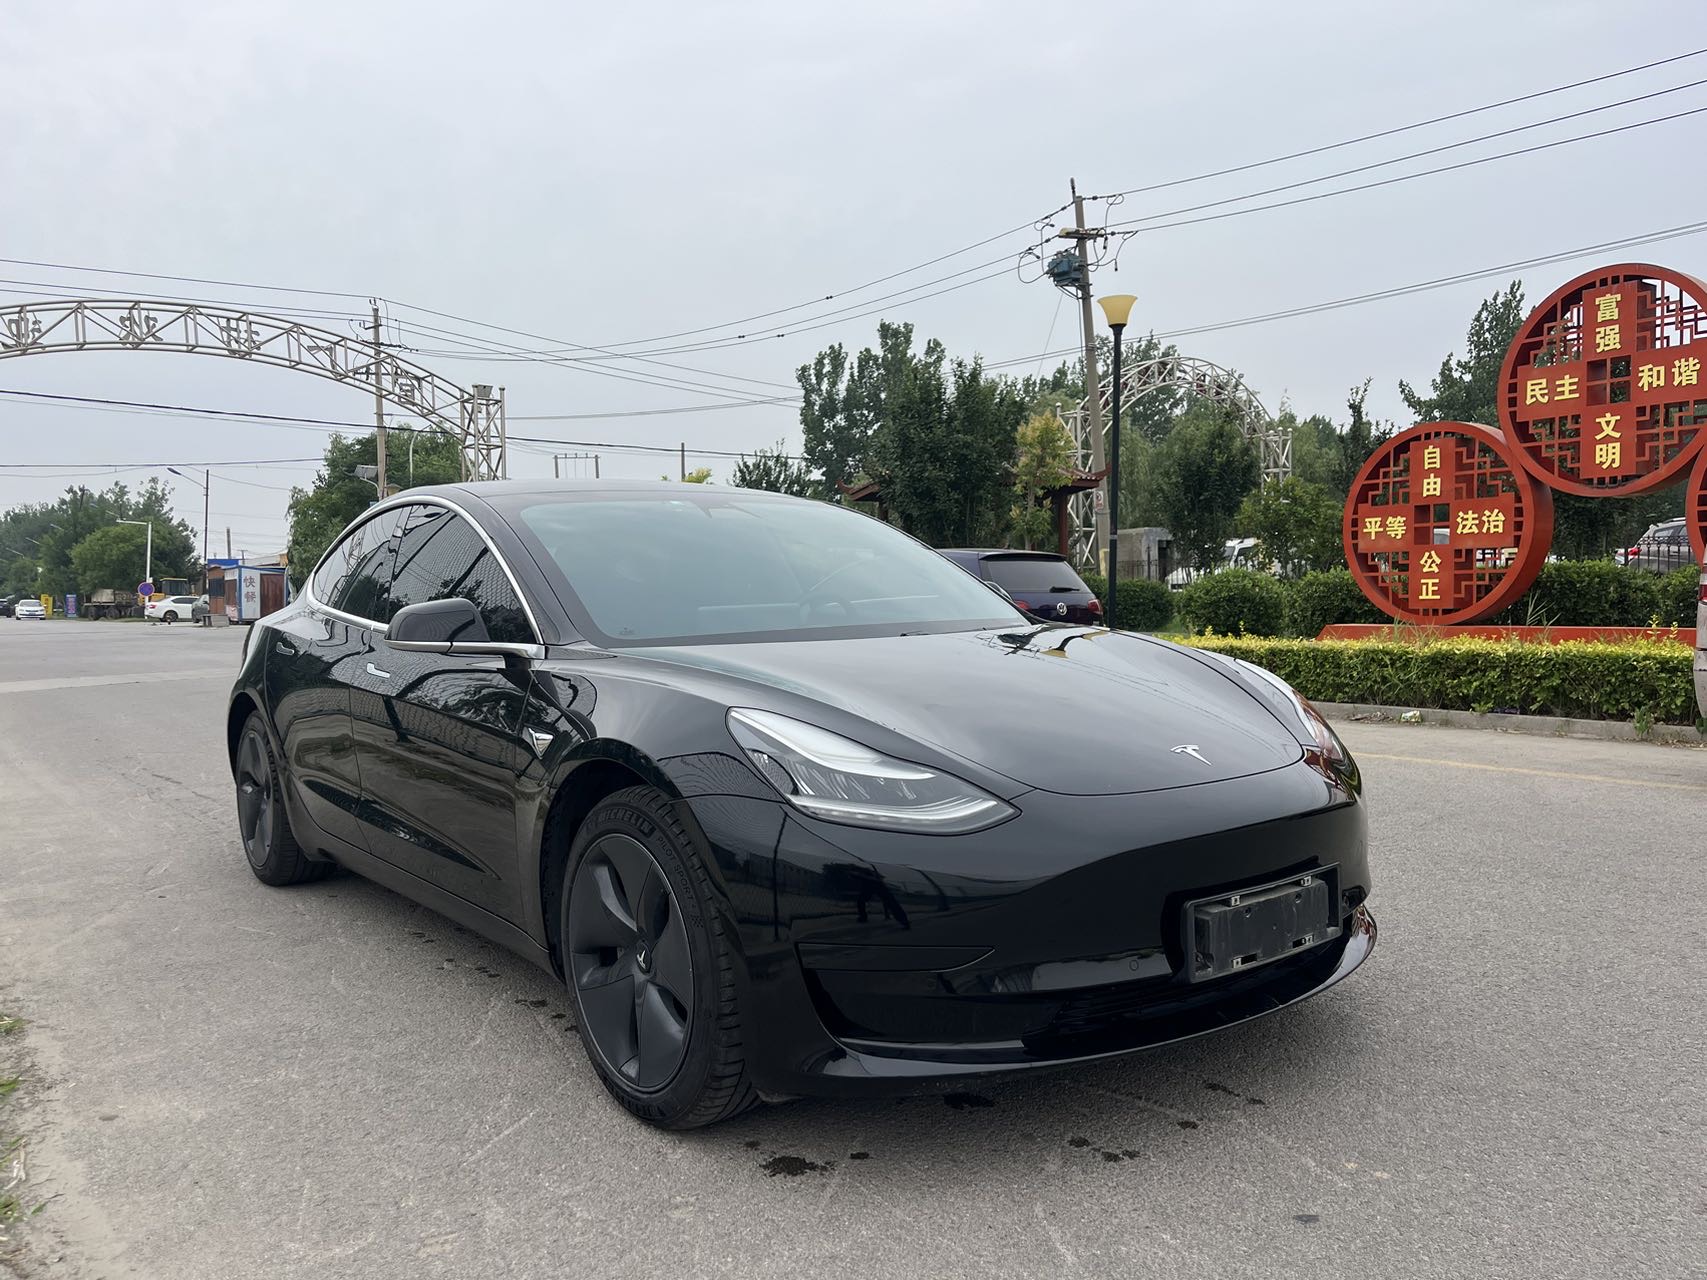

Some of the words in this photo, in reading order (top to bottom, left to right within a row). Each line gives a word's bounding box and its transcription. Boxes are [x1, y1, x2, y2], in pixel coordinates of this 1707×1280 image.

[1595, 293, 1622, 353] 富强
[1525, 374, 1580, 405] 民主
[1638, 357, 1701, 391] 和谐
[1595, 412, 1621, 469] 文明
[1422, 445, 1441, 497] 自由
[1362, 515, 1407, 540] 平等
[1456, 508, 1506, 534] 法治
[1418, 550, 1442, 600] 公正
[598, 808, 654, 835] MICHELIN
[656, 836, 676, 861] PILOT
[673, 864, 694, 901] SPORT
